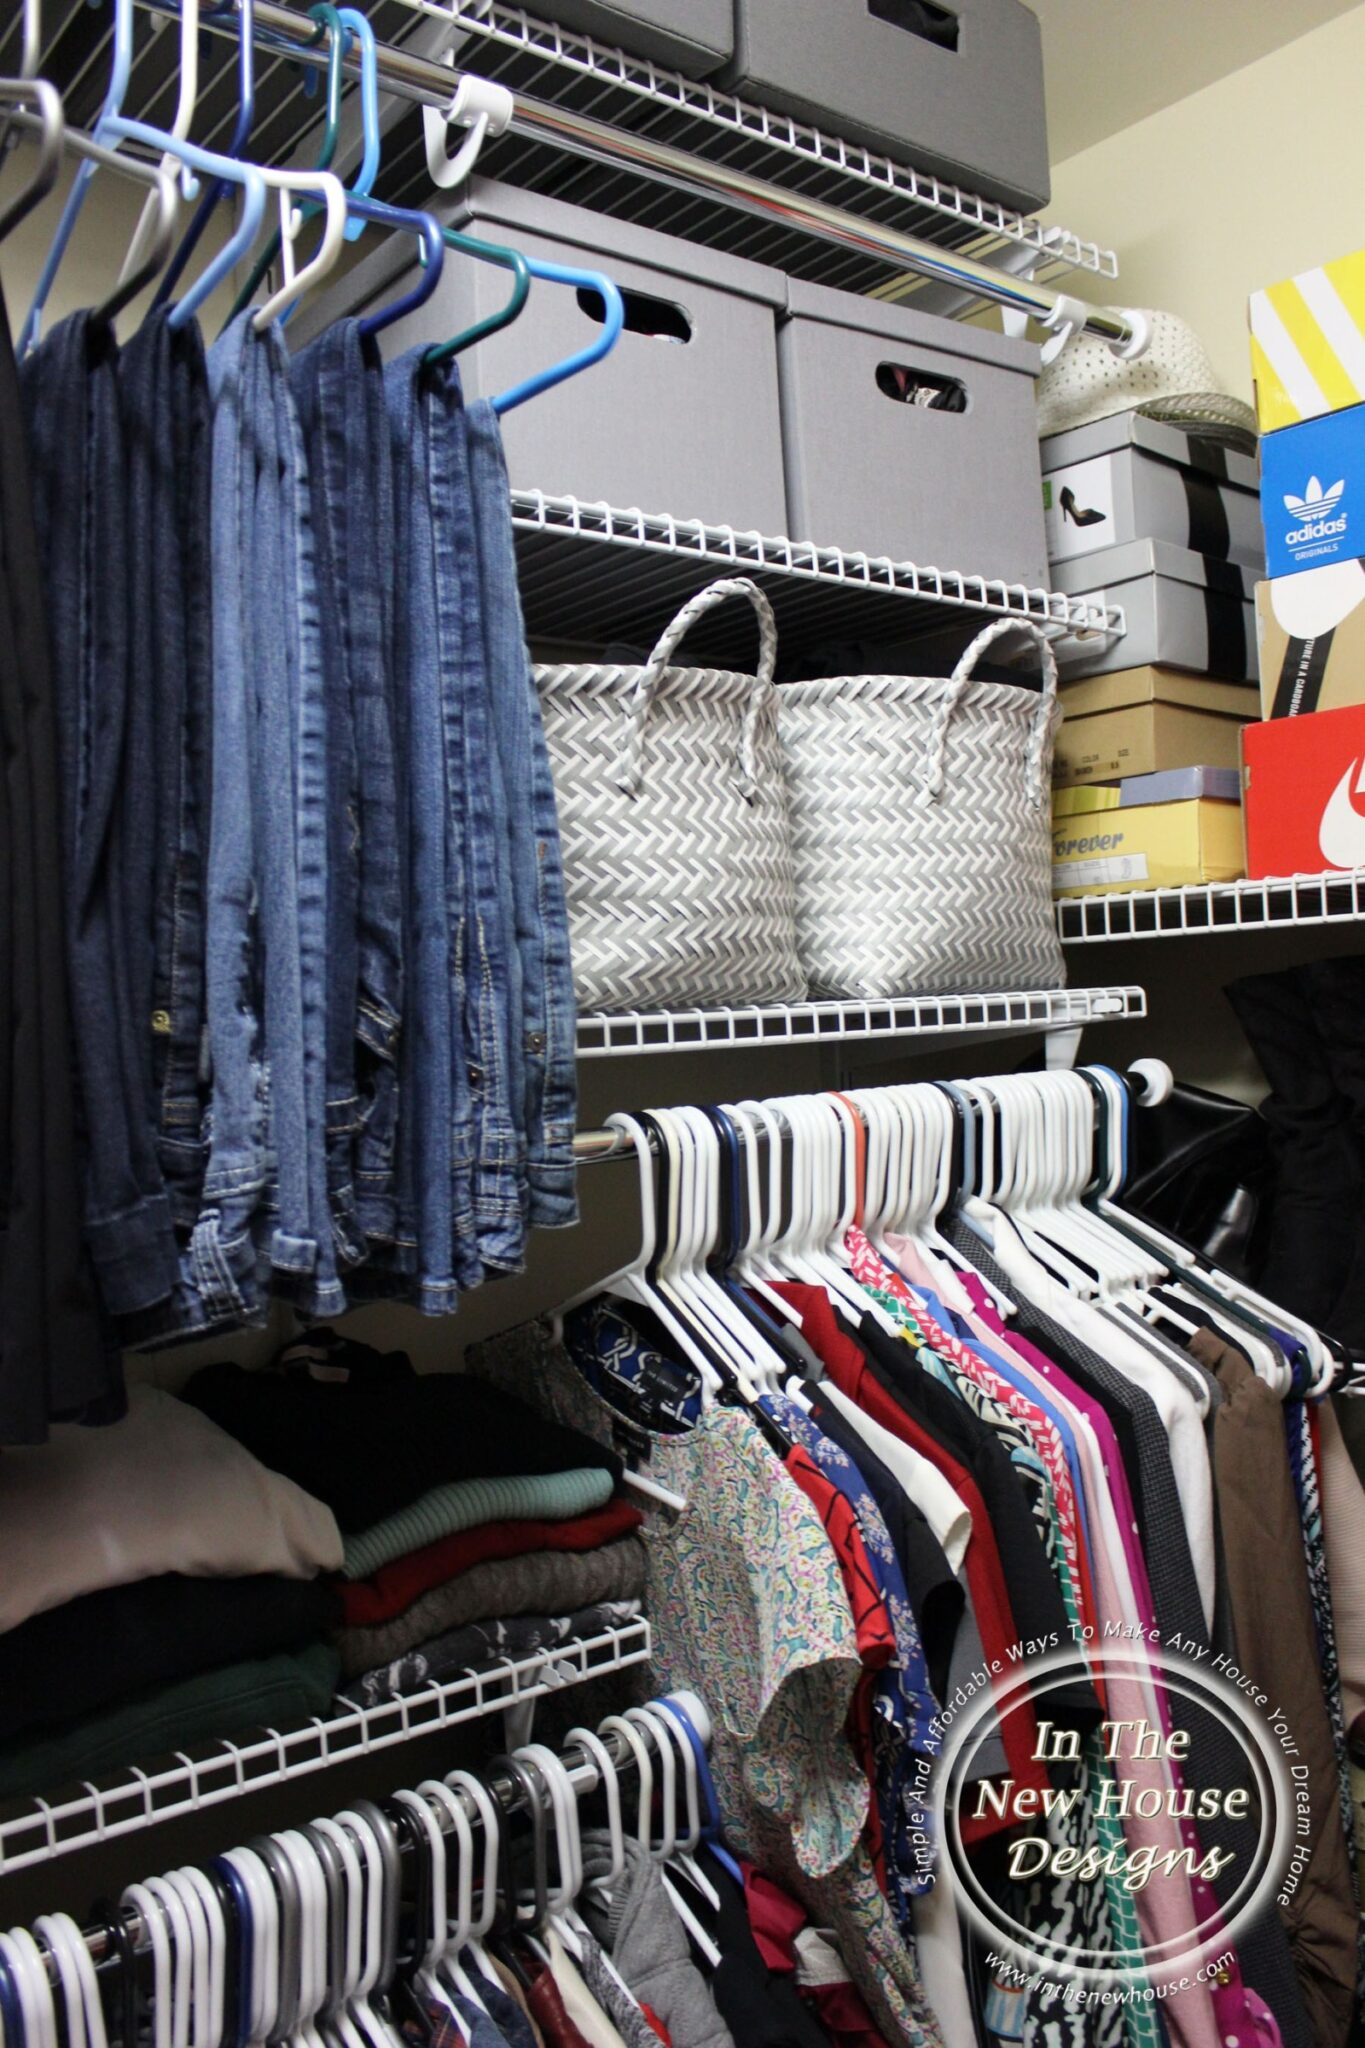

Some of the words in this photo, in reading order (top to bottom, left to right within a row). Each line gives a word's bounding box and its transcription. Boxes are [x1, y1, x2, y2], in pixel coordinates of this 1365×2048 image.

[1285, 517, 1347, 545] adidas
[1294, 543, 1339, 561] ORIGINALS
[1299, 660, 1310, 670] IN
